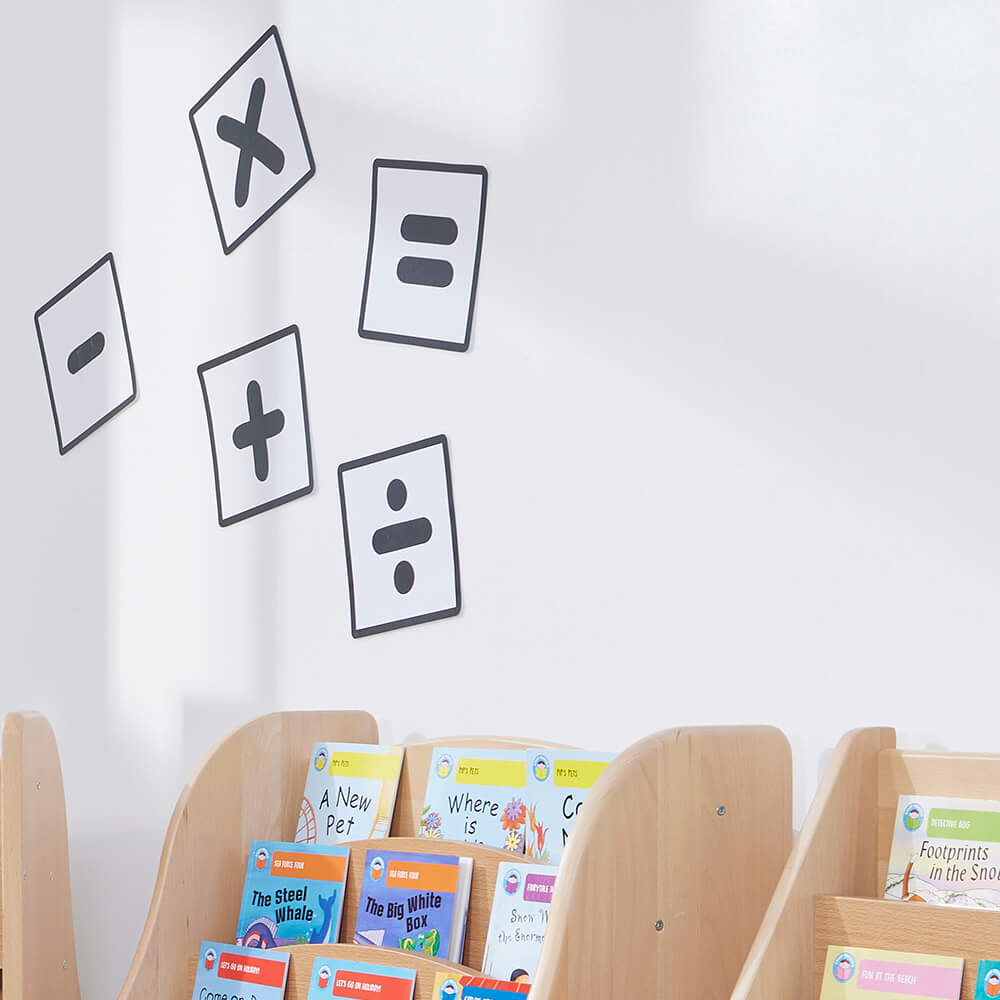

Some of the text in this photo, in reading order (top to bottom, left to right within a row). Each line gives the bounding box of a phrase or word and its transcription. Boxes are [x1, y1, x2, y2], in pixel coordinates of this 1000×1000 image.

[319, 786, 372, 812] A New
[448, 792, 499, 817] Where
[326, 814, 355, 836] Pet
[464, 817, 477, 835] is
[920, 840, 989, 864] Footprints
[929, 863, 942, 880] in
[946, 864, 967, 881] the
[252, 886, 307, 907] The Steel
[366, 892, 442, 920] The Big White
[275, 905, 313, 924] Whale
[406, 915, 428, 933] Box
